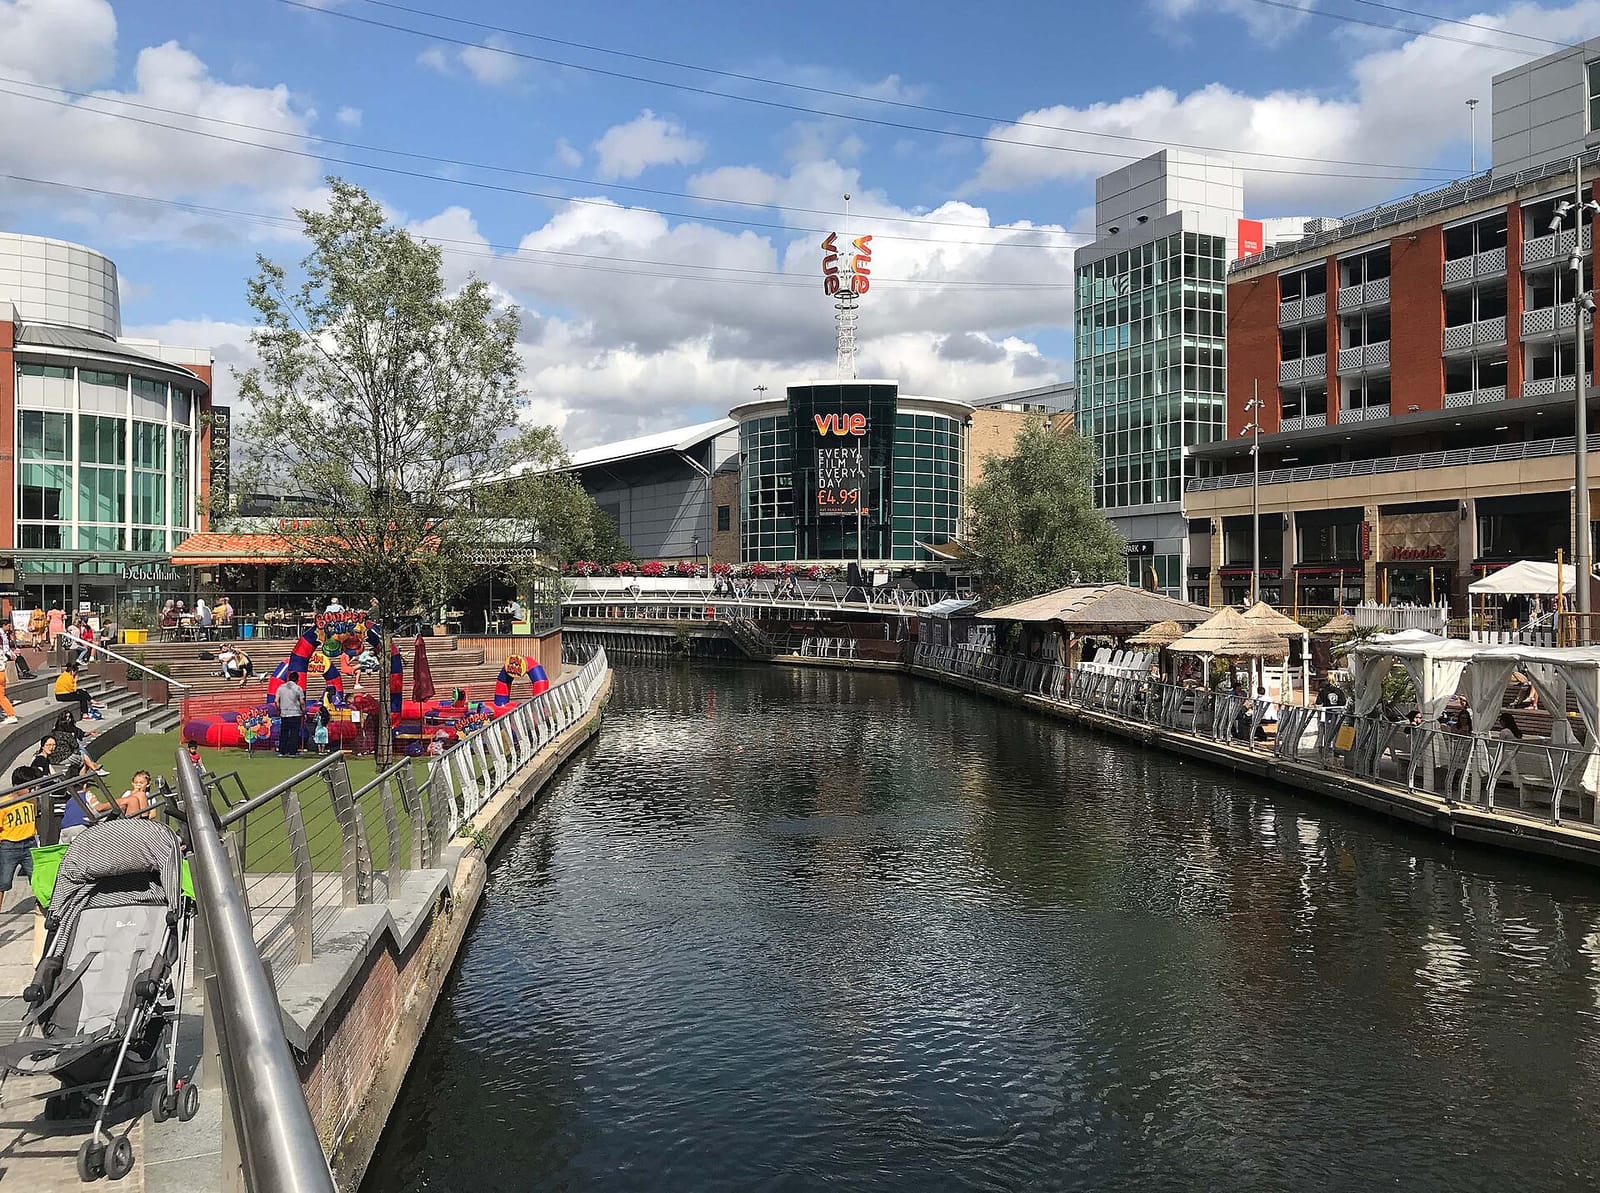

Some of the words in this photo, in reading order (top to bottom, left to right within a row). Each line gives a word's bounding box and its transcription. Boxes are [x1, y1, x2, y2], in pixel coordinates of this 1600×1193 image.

[852, 235, 873, 294] vue
[814, 413, 867, 436] vue
[818, 448, 857, 459] EVERY
[818, 459, 846, 469] FILM
[818, 468, 857, 479] EVERY
[818, 479, 842, 489] DAY
[817, 489, 858, 505] £4.99
